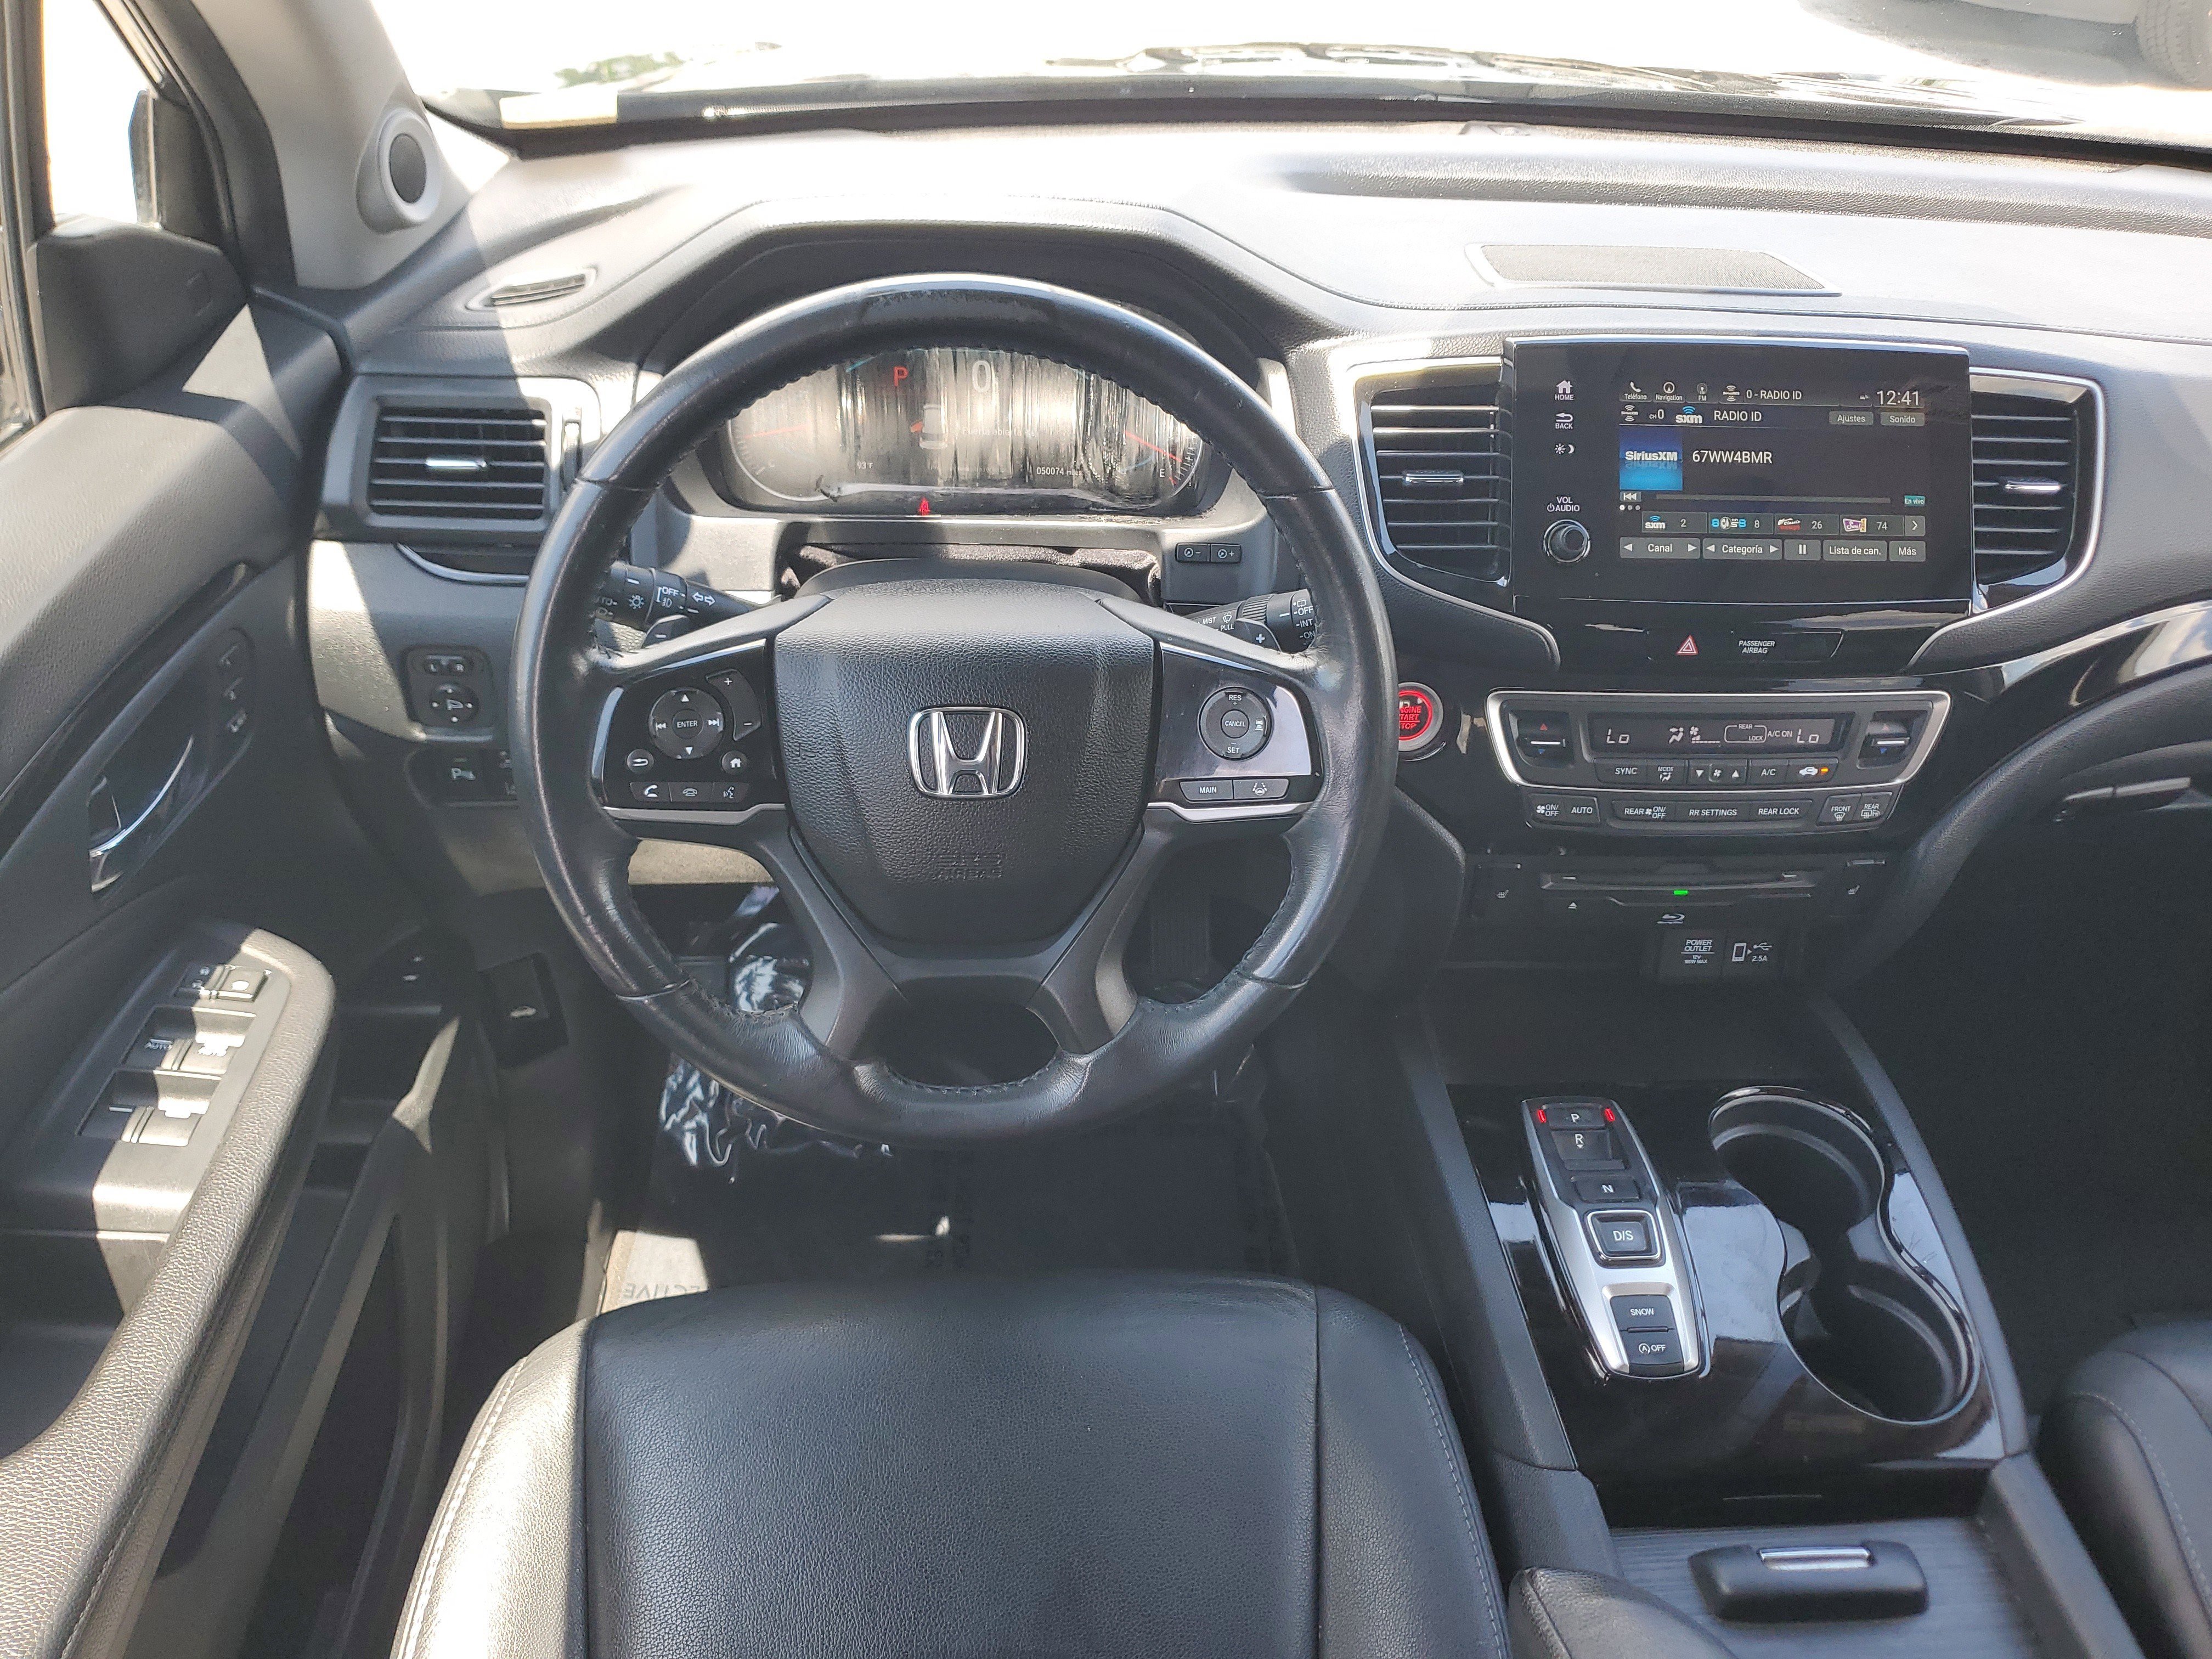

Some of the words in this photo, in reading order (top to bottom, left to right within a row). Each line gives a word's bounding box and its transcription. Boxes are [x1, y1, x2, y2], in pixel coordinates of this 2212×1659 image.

[894, 366, 909, 386] P
[972, 360, 992, 393] 0
[1746, 390, 1752, 399] 0
[1760, 390, 1790, 400] RADIO
[1792, 391, 1802, 400] ID
[1877, 390, 1919, 405] 12:41
[1675, 414, 1702, 424] sxm
[1714, 410, 1748, 421] RADIO
[1751, 411, 1762, 421] ID
[1837, 414, 1865, 423] Ajustes
[1889, 415, 1915, 424] Sonido
[1625, 450, 1678, 461] SiriusXM
[1692, 450, 1773, 464] 67WW4BMR
[1036, 467, 1064, 476] 050074
[1159, 469, 1165, 478] E
[1680, 519, 1687, 527] 2
[1754, 520, 1760, 528] 8
[1811, 521, 1823, 529] 26
[1876, 522, 1888, 531] 74
[1647, 544, 1672, 552] Canal
[1722, 544, 1763, 555] Categoría
[1829, 546, 1849, 555] Lista
[1851, 546, 1861, 555] de
[1898, 546, 1916, 555] Más
[662, 586, 679, 596] OFF
[1300, 619, 1313, 628] INT
[1606, 728, 1629, 743] Lo
[1797, 728, 1819, 743] Lo
[1570, 1113, 1580, 1123] P
[1575, 1133, 1584, 1144] R
[1602, 1184, 1614, 1194] N
[1613, 1230, 1634, 1242] D/S
[1630, 1308, 1655, 1317] SNOW
[1651, 1344, 1666, 1352] OFF
